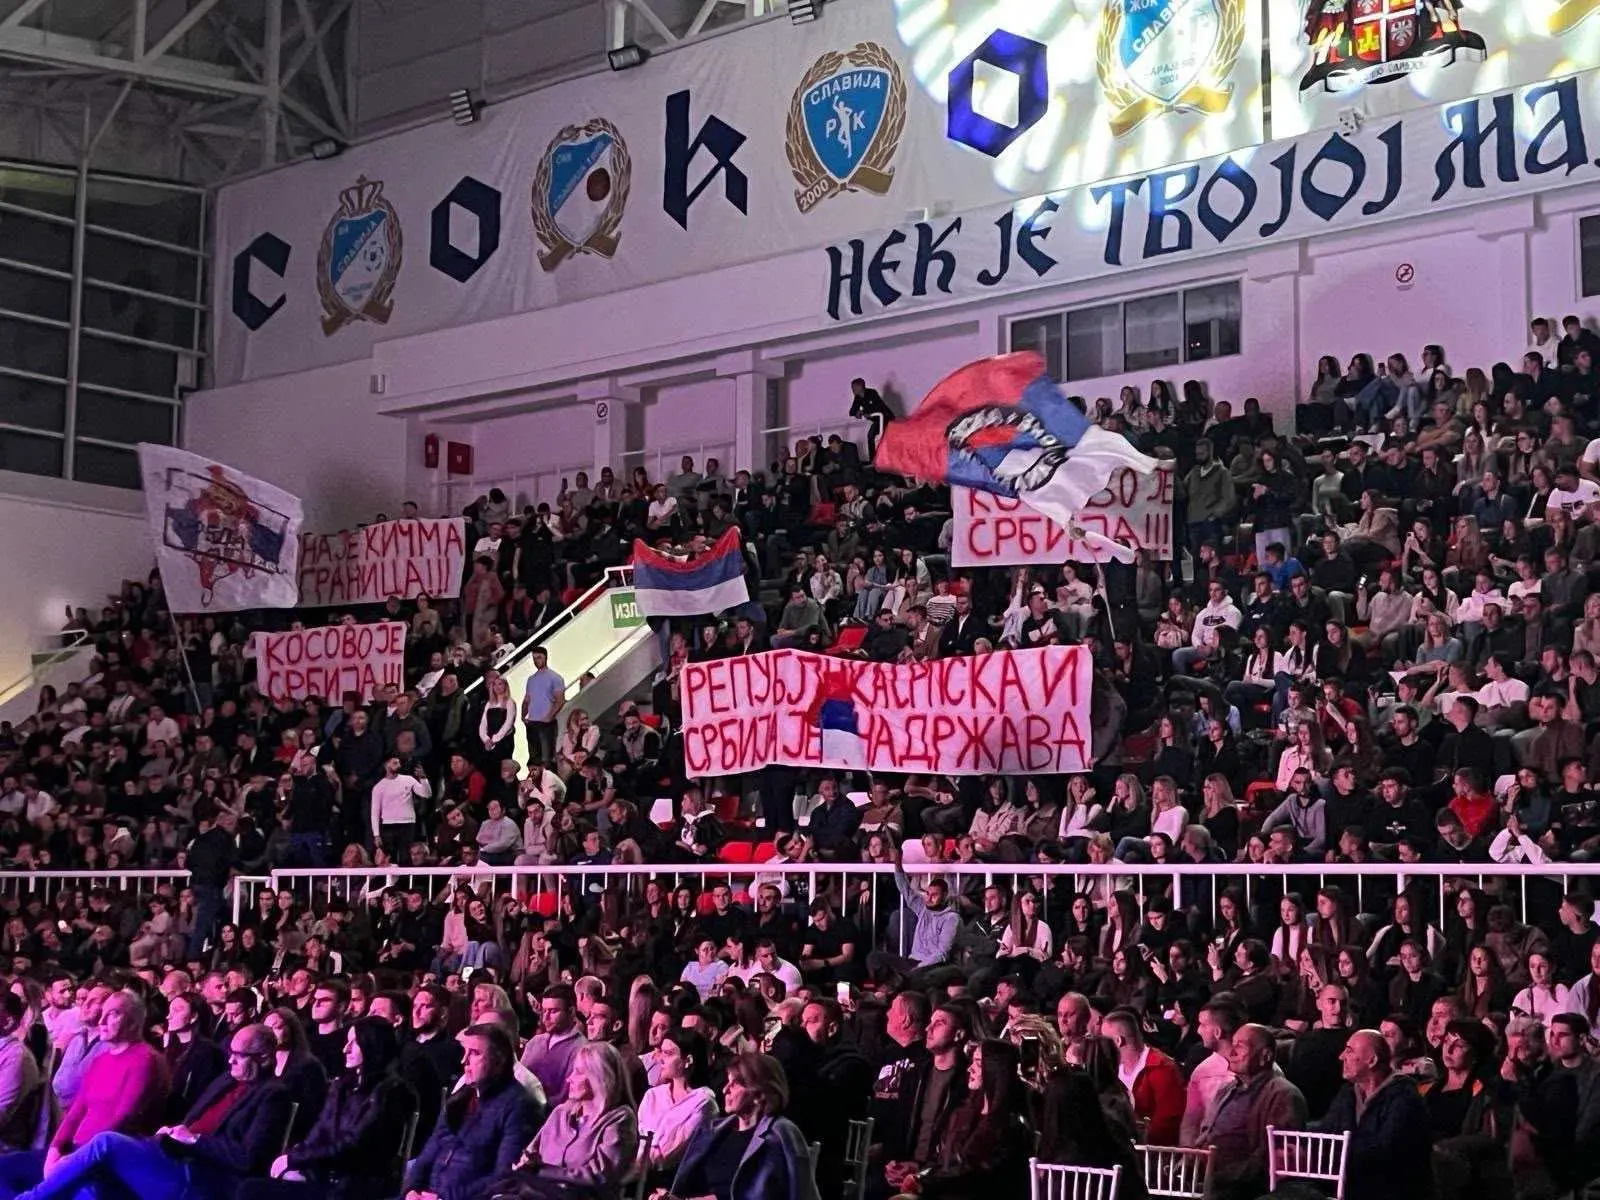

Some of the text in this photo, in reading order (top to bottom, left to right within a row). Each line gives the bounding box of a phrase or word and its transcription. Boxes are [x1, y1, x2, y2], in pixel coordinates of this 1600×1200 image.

[810, 72, 882, 105] СЛАВИЈА
[800, 178, 830, 210] 2000
[825, 76, 1600, 320] НЕК ЈЕ ТВОЈОЈ МА
[363, 519, 464, 561] КИЧМА
[1040, 647, 1079, 706] И
[899, 710, 1091, 773] ДРЖАВА
